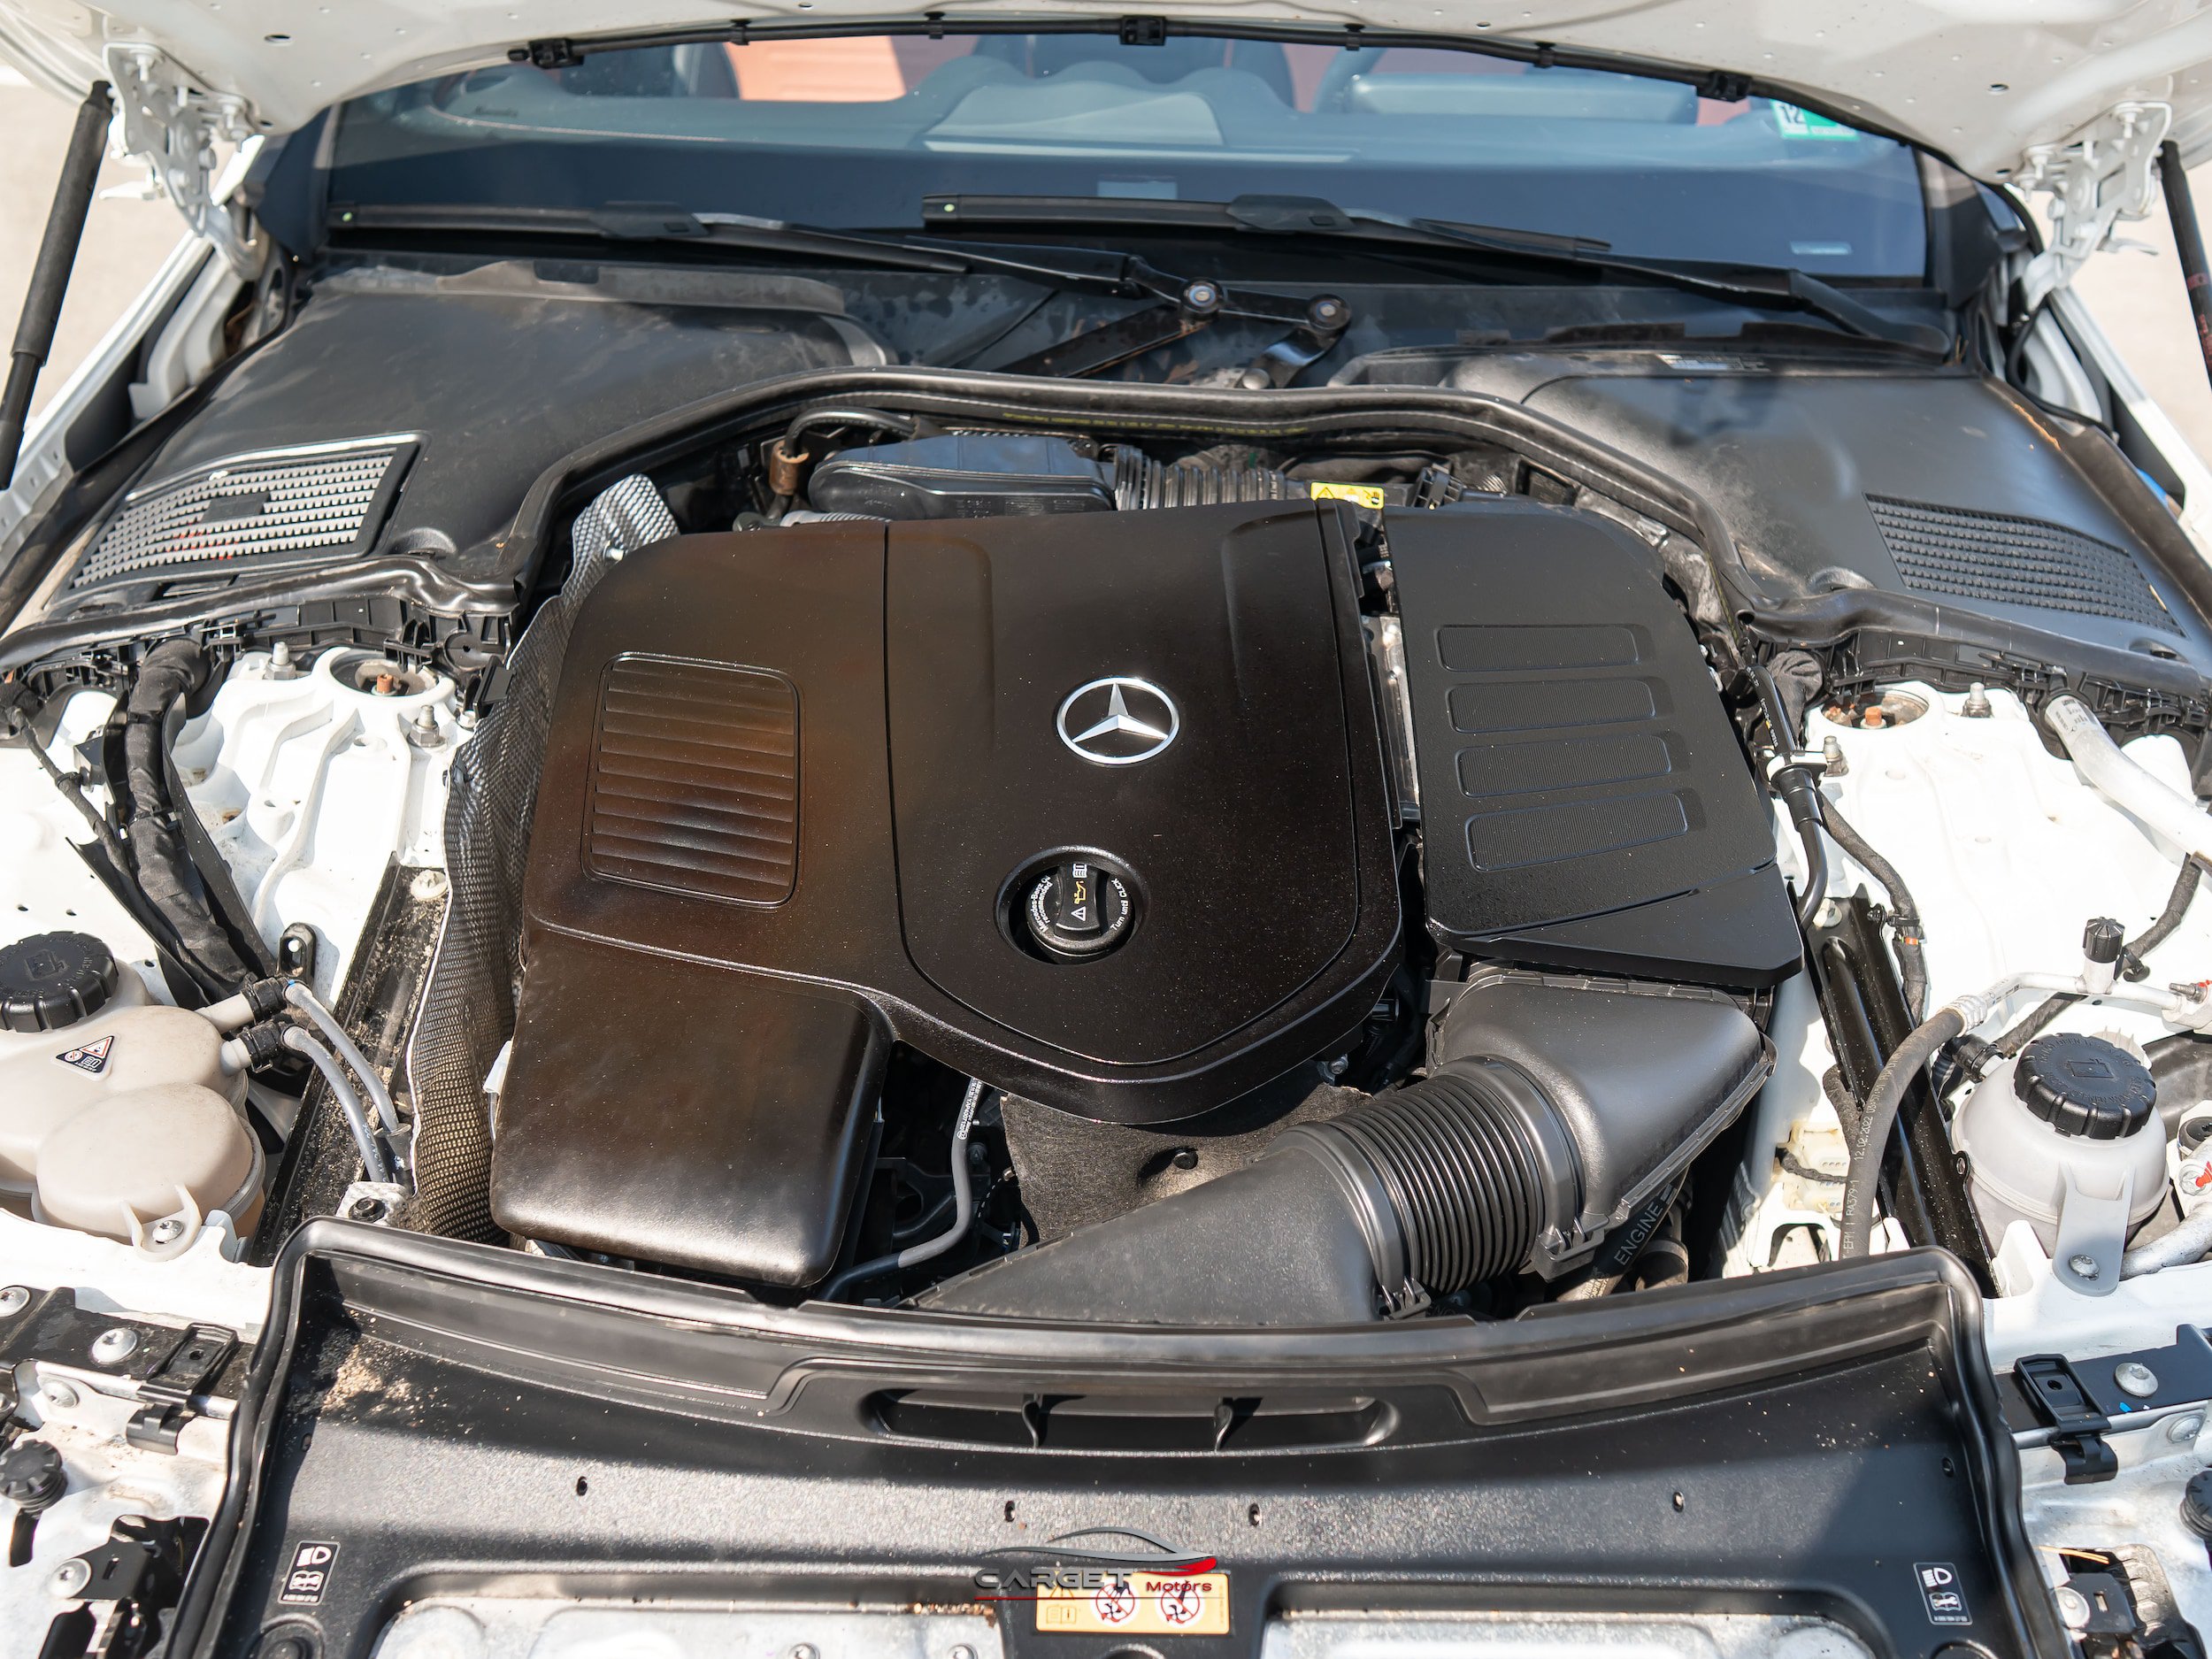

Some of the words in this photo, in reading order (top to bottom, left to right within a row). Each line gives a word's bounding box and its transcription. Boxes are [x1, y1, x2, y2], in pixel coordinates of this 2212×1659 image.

[1030, 881, 1048, 933] Mercedes-Benz
[1038, 882, 1053, 924] recommended
[1110, 878, 1127, 898] CLICK
[1110, 916, 1125, 931] Turn
[1614, 1202, 1663, 1265] ENGINE
